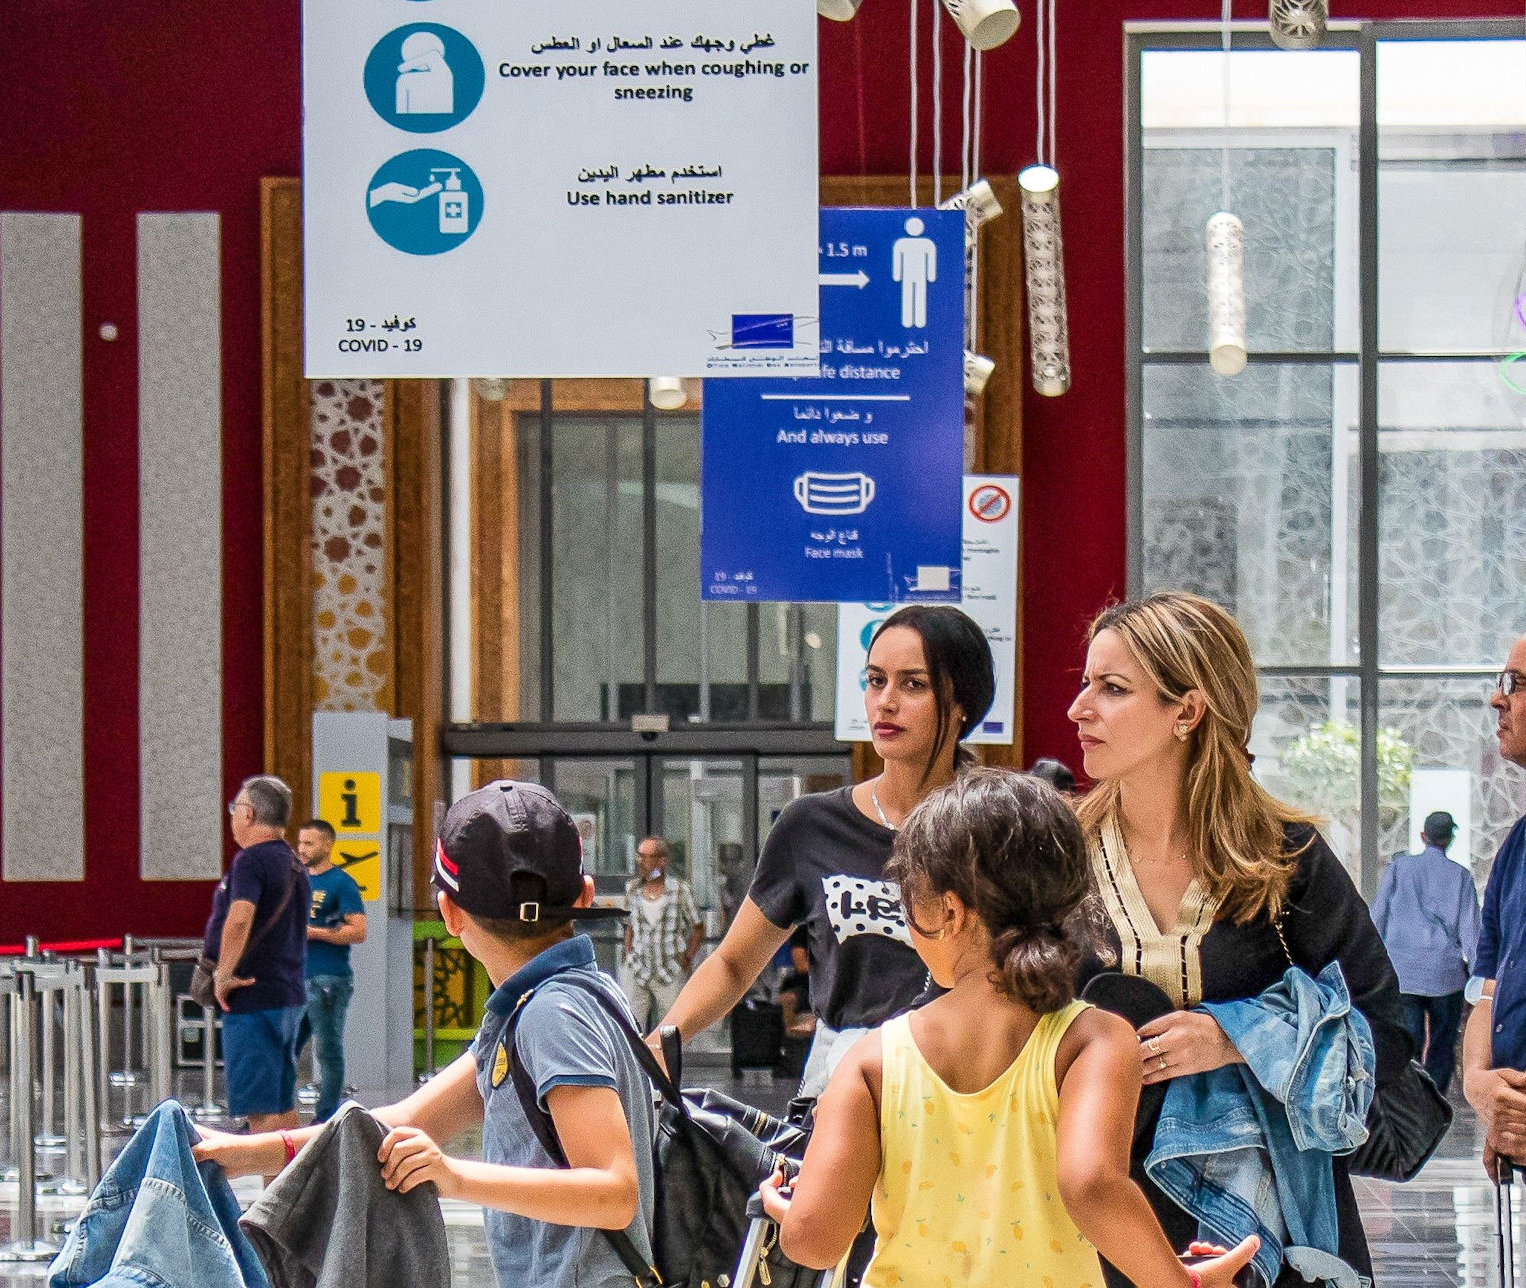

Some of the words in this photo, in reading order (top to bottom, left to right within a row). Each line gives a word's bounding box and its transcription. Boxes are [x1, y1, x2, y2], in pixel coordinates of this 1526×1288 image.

[531, 36, 580, 55] العطس
[606, 35, 653, 53] السعال
[659, 36, 684, 49] عند
[690, 35, 735, 54] وجهك
[739, 33, 776, 55] غطي
[499, 62, 551, 78] Cover
[556, 65, 598, 81] your
[602, 60, 640, 77] face
[645, 60, 695, 76] when
[701, 59, 785, 79] coughing
[789, 62, 810, 75] or
[614, 84, 694, 102] sneezing
[577, 165, 619, 183] اليدين
[624, 163, 666, 183] مطهر
[671, 165, 722, 184] استخدم
[567, 191, 601, 206] Use
[606, 189, 652, 206] hand
[657, 189, 734, 205] sanitizer
[827, 242, 849, 257] 1.5
[852, 245, 868, 257] m
[345, 318, 366, 332] 19
[381, 314, 417, 333] كوفيد
[338, 339, 389, 353] COVID
[404, 338, 423, 352] 19
[821, 363, 836, 379] fe
[839, 364, 901, 380] distance
[777, 429, 807, 444] And
[810, 429, 860, 447] always
[862, 433, 889, 445] use
[805, 546, 832, 559] Face
[833, 547, 864, 559] mask
